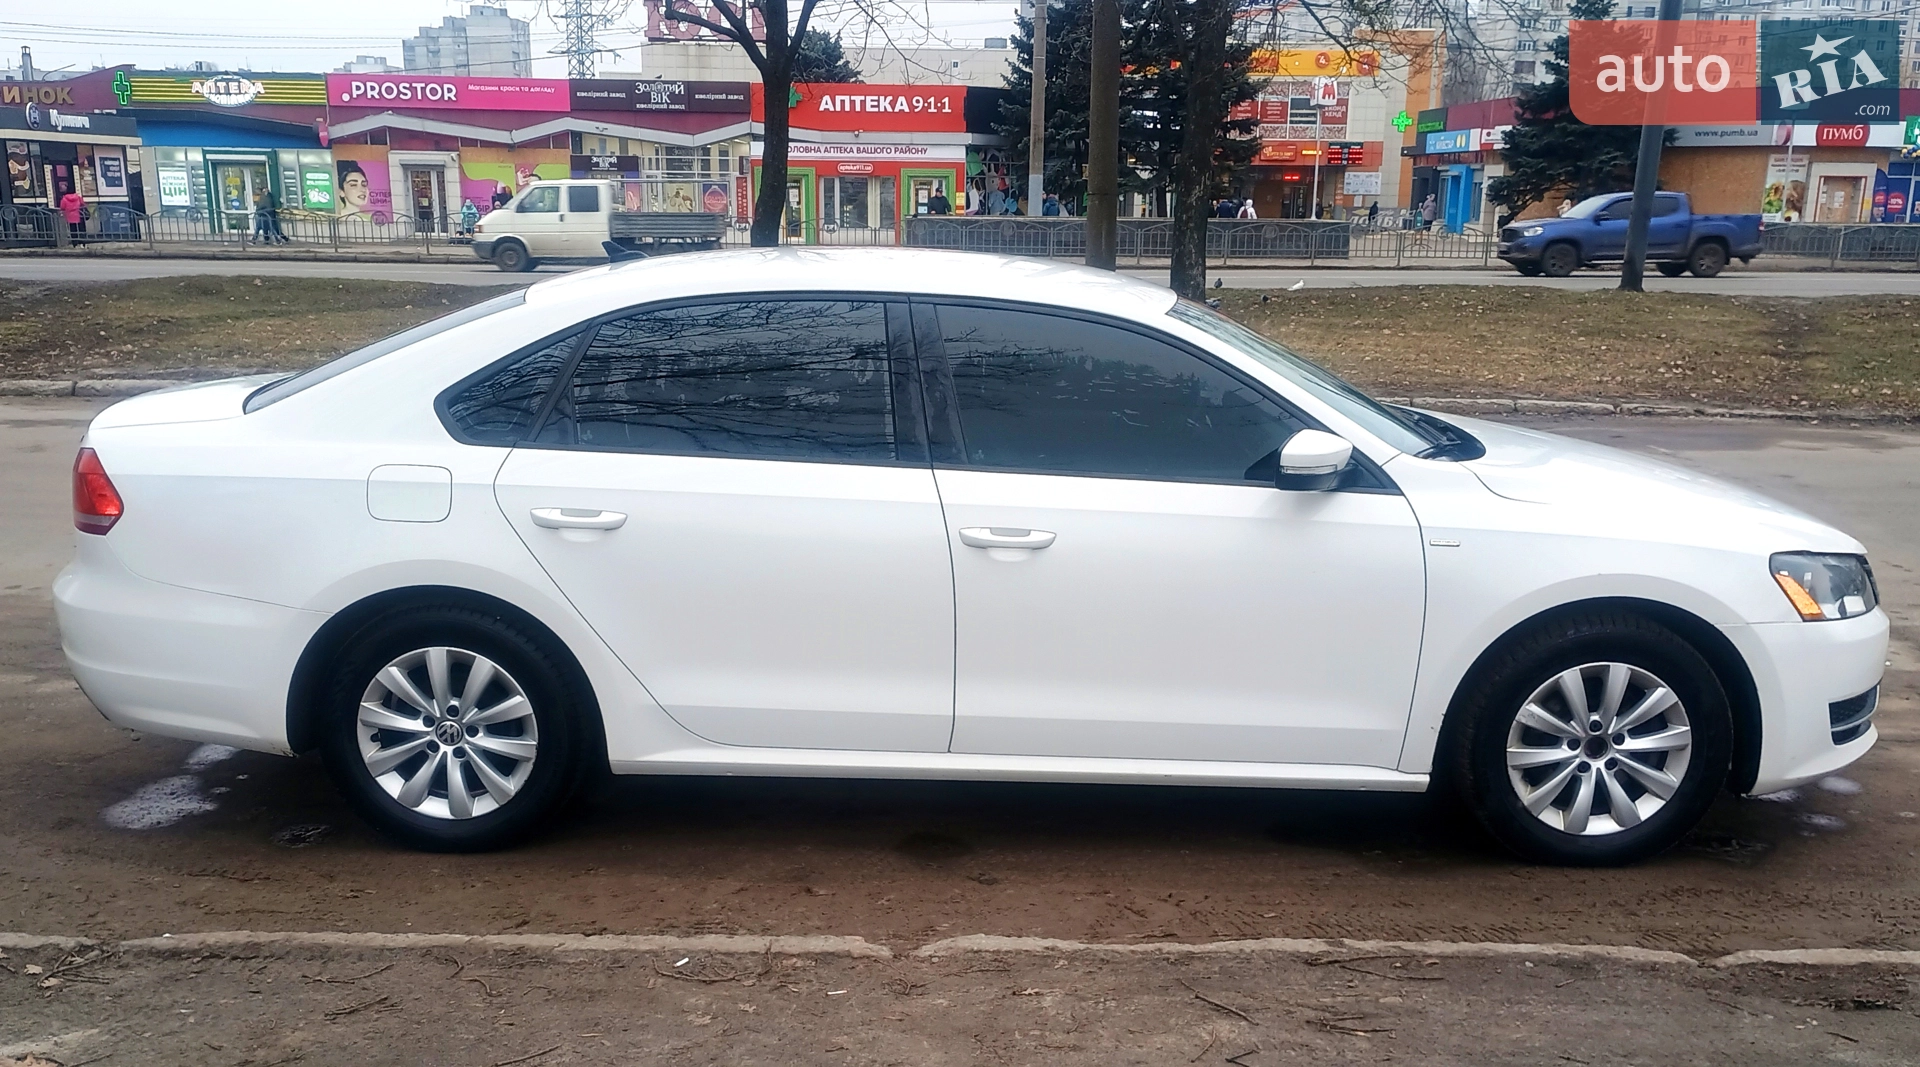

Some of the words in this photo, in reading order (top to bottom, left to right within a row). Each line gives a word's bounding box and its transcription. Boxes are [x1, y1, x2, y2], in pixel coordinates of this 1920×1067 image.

[191, 81, 265, 94] АПТЕКА
[2, 86, 74, 105] ИНОК
[818, 95, 910, 113] АПТЕКА
[1694, 128, 1759, 138] www.pumb.ua
[787, 145, 822, 154] ОЛОВНА
[823, 146, 855, 155] АПТЕКА
[856, 147, 892, 155] ВАШОГО
[894, 146, 928, 156] РАЙОНУ
[162, 186, 188, 198] ЦІН
[475, 204, 491, 213] БІР
